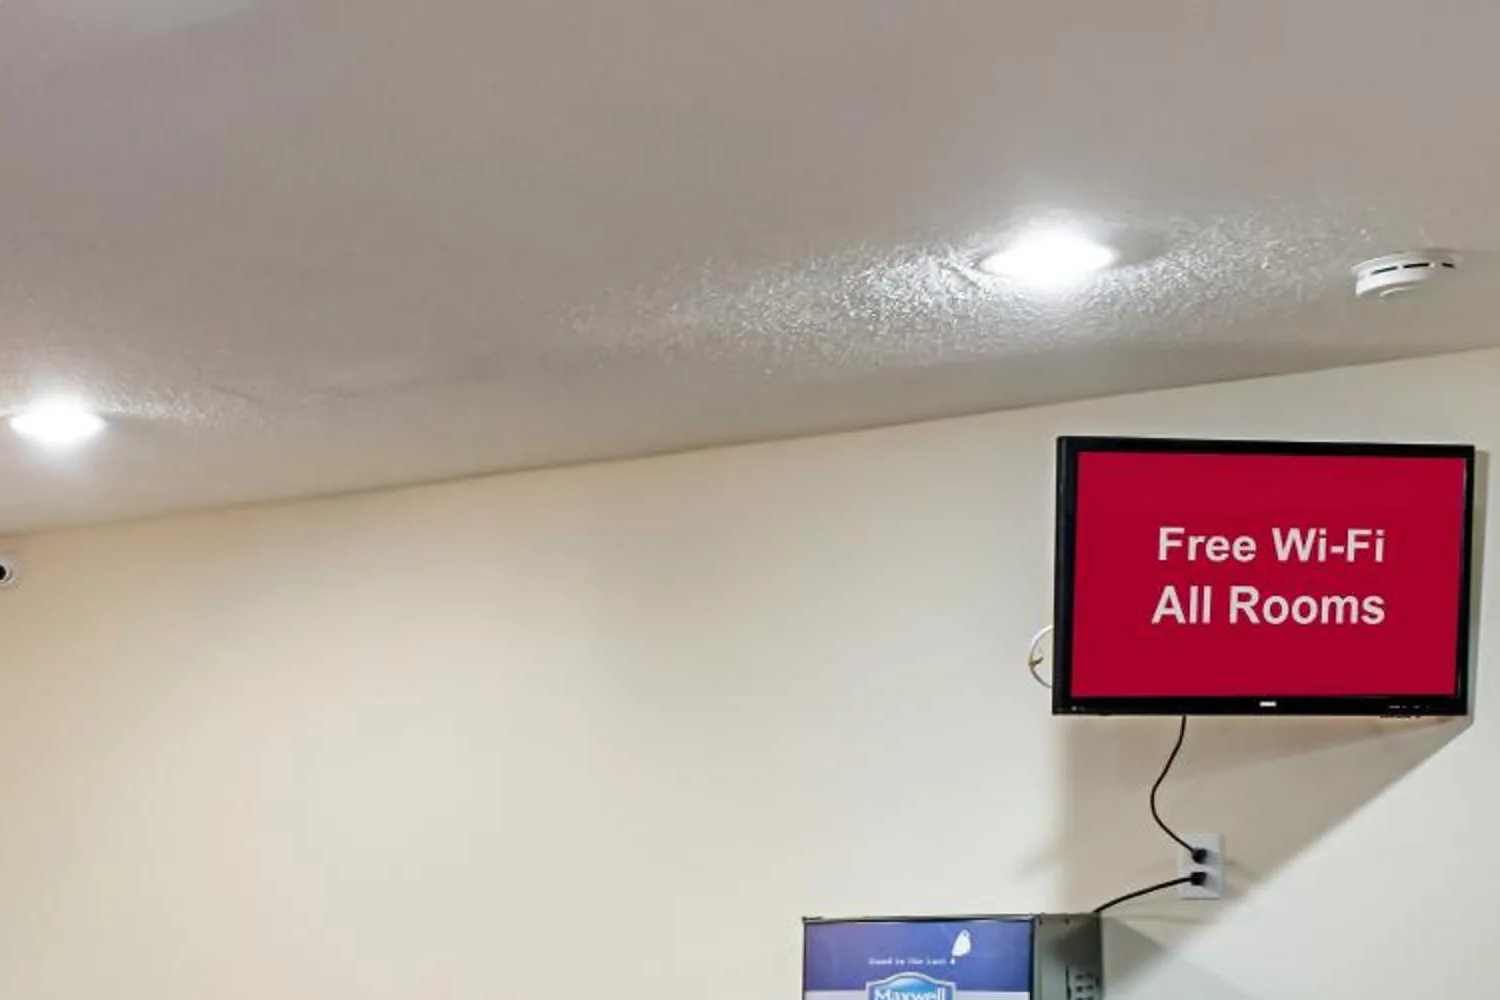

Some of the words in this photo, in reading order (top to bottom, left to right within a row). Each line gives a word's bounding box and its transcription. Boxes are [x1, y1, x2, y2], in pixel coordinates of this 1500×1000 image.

[1157, 526, 1257, 562] Free
[1271, 527, 1385, 563] Wi-Fi
[1151, 585, 1212, 625] All
[1229, 585, 1386, 625] Rooms
